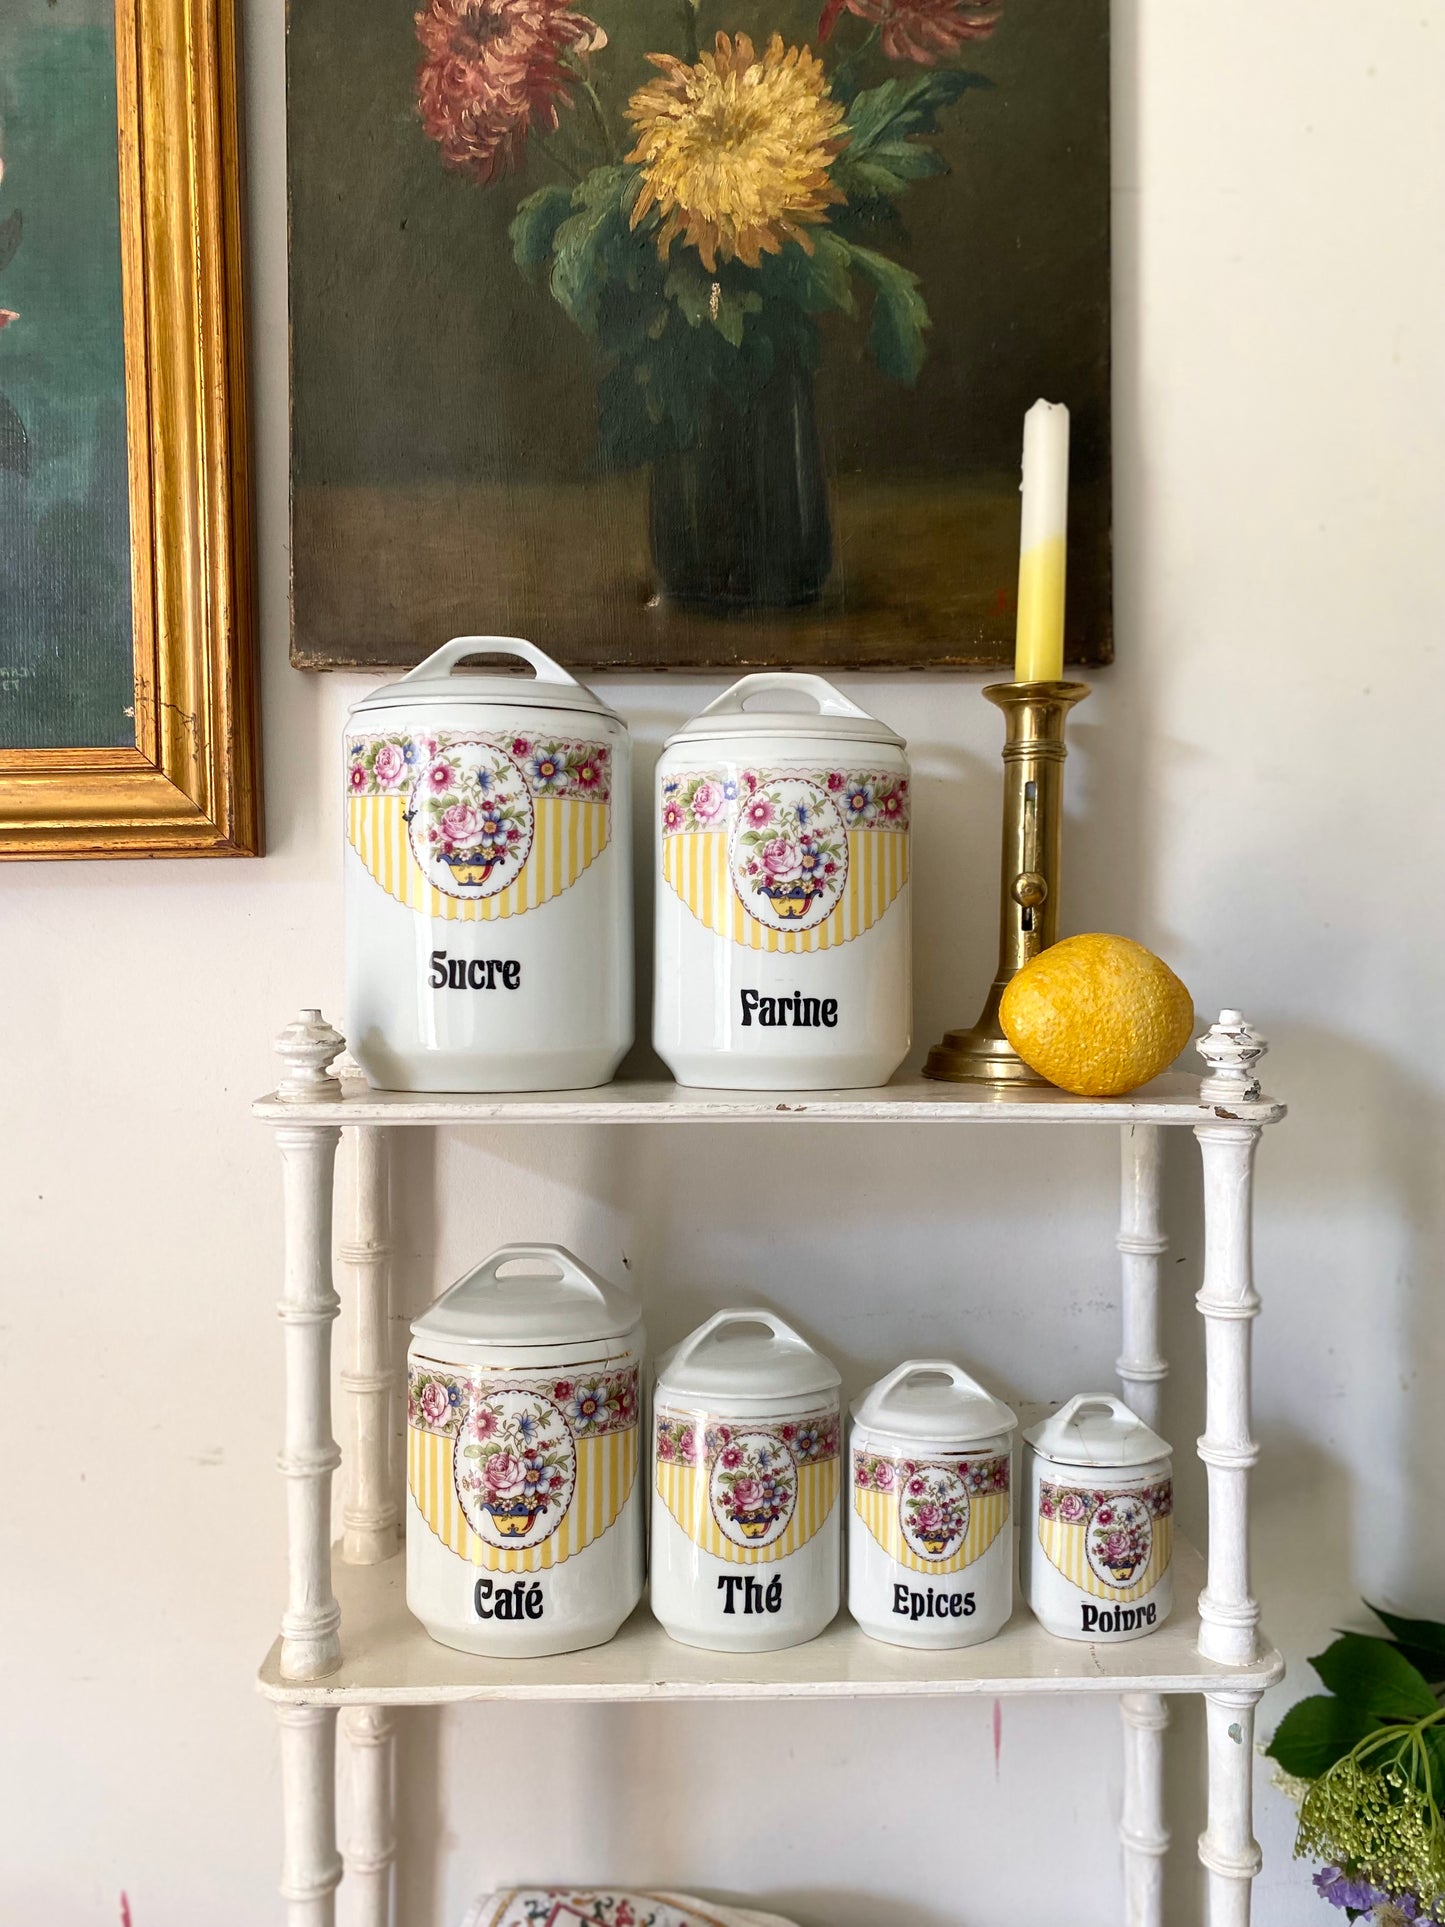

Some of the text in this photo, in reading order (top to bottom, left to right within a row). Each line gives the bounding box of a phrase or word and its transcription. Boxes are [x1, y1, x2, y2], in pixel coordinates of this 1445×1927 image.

[428, 951, 521, 990] Sucre
[740, 989, 838, 1028] Farine
[474, 1578, 544, 1620] Café
[717, 1573, 782, 1615] Thé
[892, 1583, 977, 1621] Epices
[1081, 1601, 1157, 1633] Poivre
